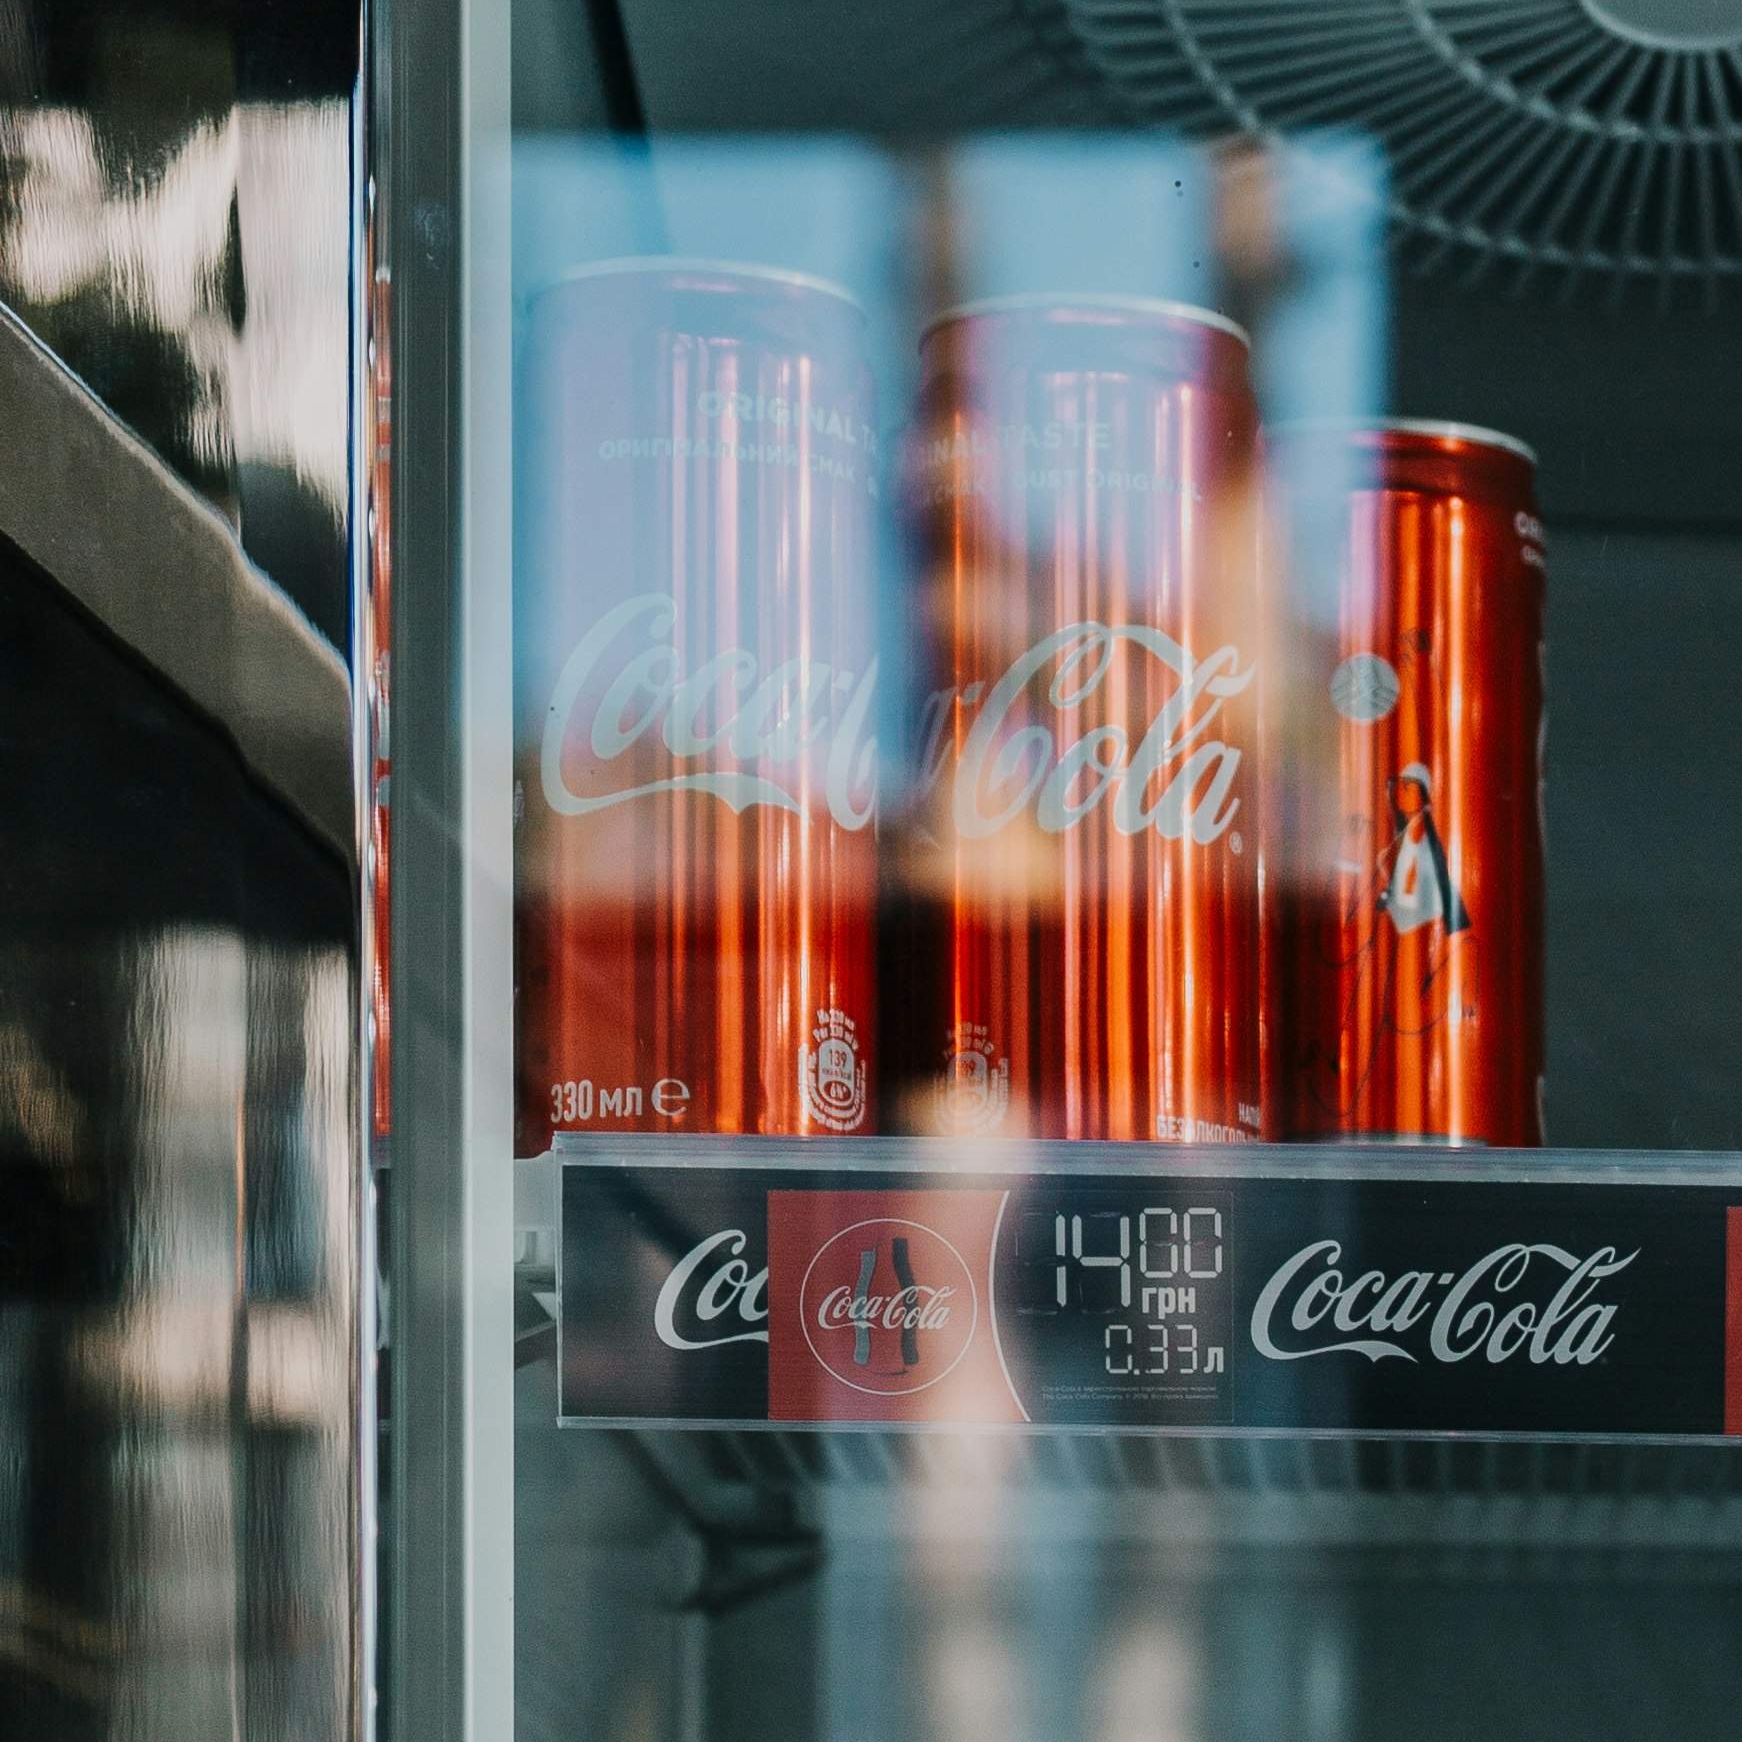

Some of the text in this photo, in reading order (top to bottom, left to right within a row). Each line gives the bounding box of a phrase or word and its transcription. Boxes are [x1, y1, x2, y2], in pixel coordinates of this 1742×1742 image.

[698, 390, 857, 445] ORIGINAL
[551, 1079, 594, 1124] 330
[599, 1086, 643, 1118] мл
[817, 1285, 958, 1331] Coca-Cola
[1141, 1286, 1197, 1320] грн
[1249, 1238, 1642, 1365] Coca-Cola
